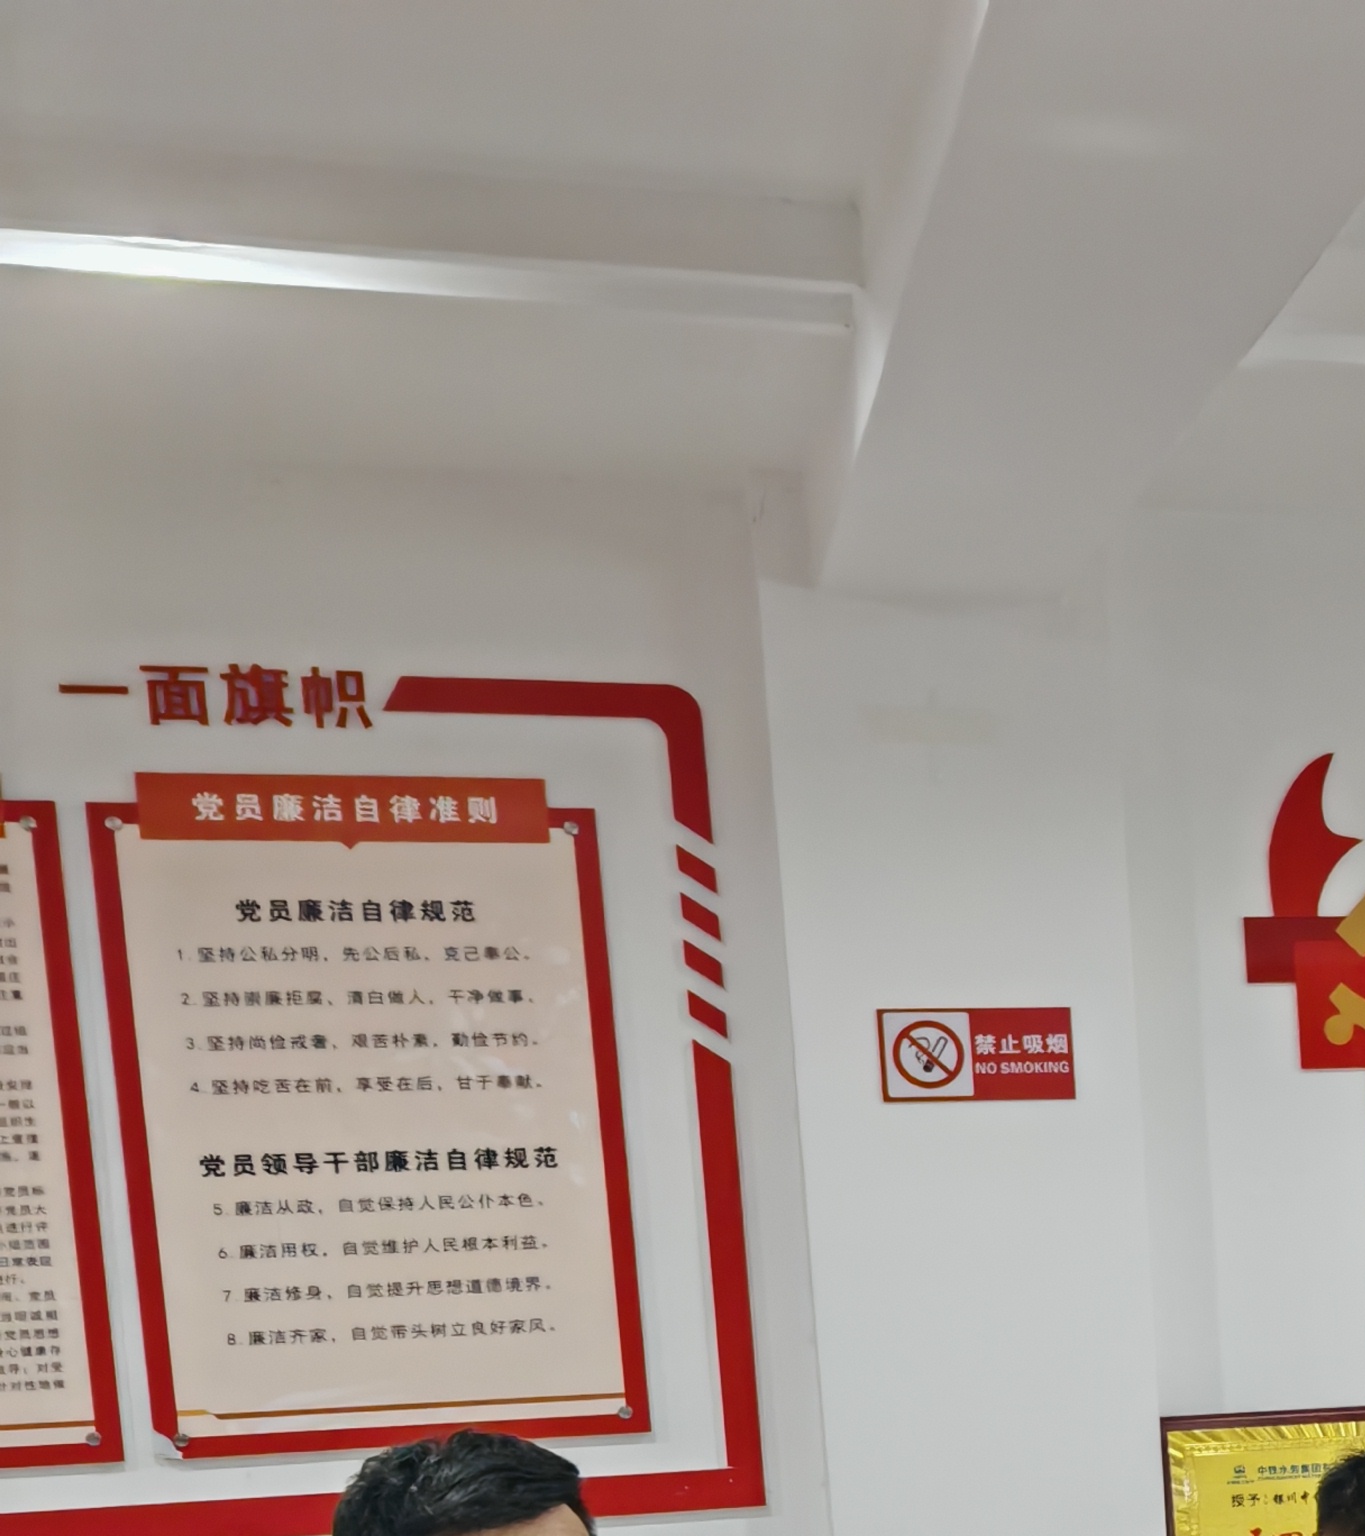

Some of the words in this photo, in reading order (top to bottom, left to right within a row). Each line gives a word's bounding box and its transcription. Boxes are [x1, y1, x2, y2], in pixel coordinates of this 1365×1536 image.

[59, 663, 374, 730] 一面旗帜
[191, 791, 499, 826] 党员廉洁自律准则
[235, 898, 478, 924] 党员廉洁自律规范
[974, 1034, 1069, 1056] 禁止吸烟
[975, 1061, 997, 1075] NO
[1000, 1060, 1070, 1075] SMOKING
[199, 1146, 559, 1179] 党员领导干部廉洁自律规范
